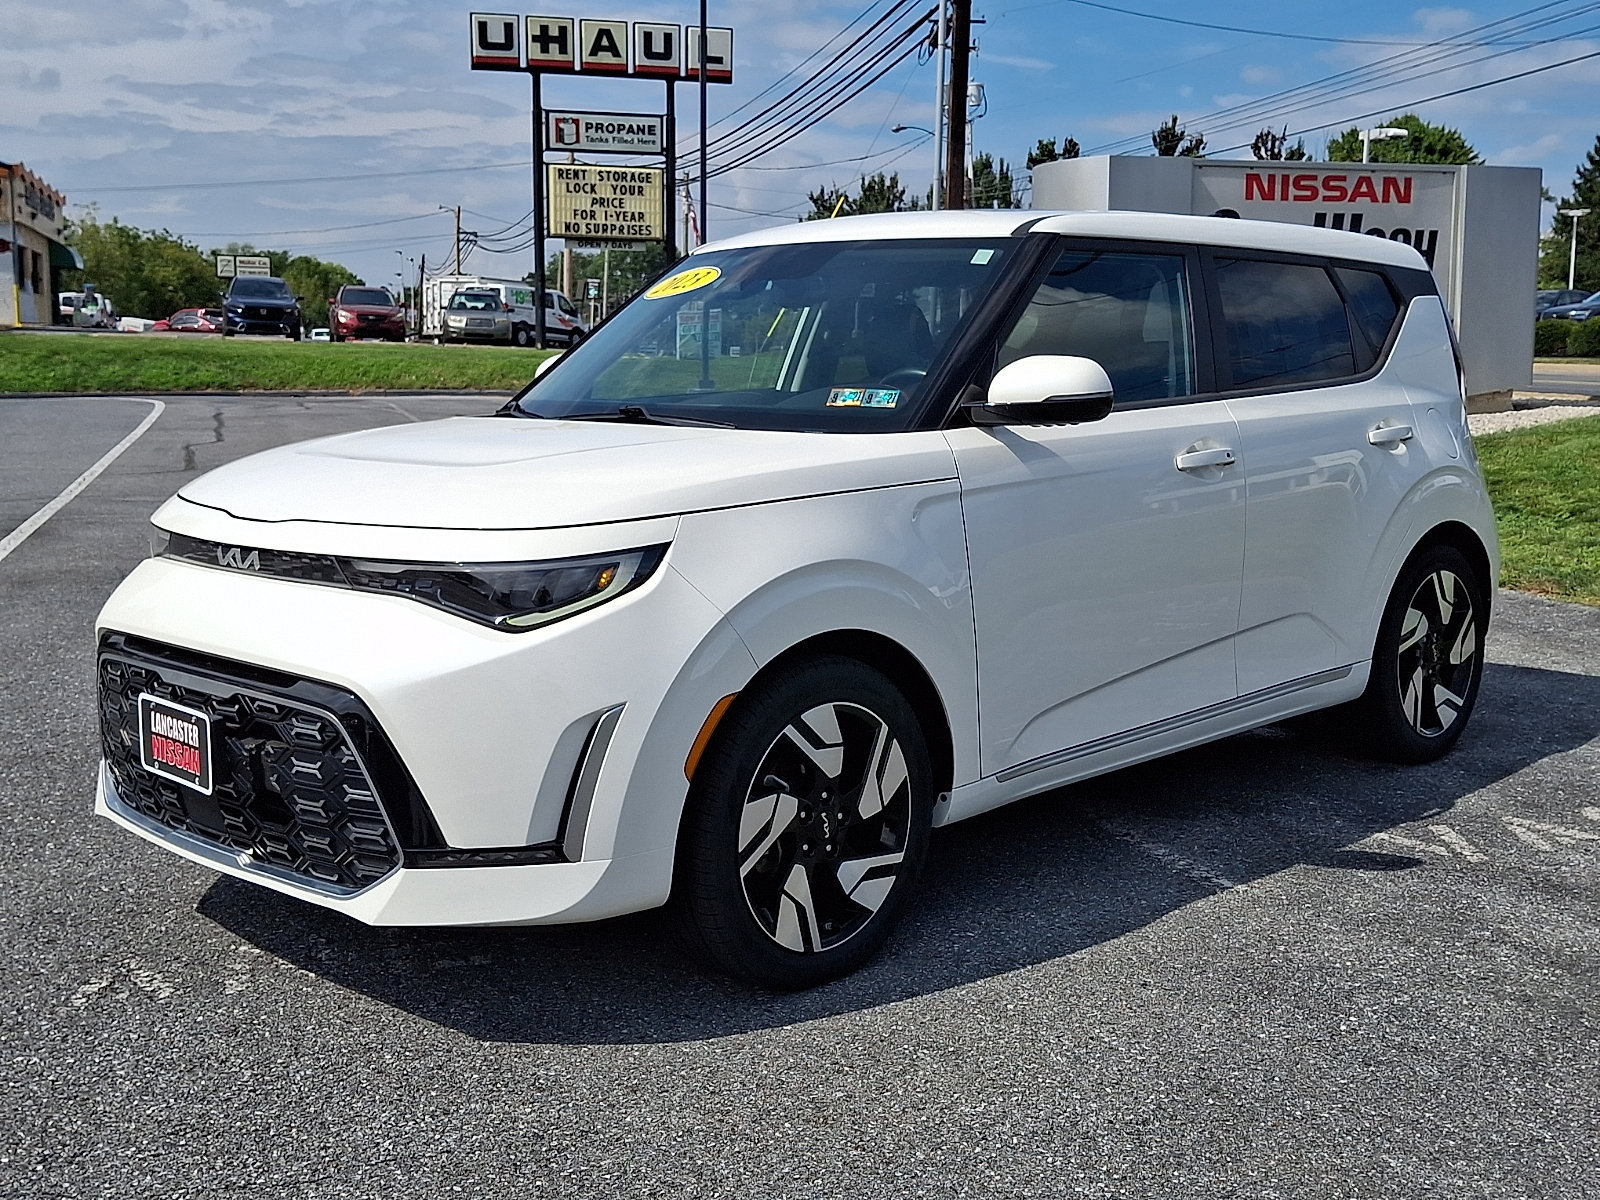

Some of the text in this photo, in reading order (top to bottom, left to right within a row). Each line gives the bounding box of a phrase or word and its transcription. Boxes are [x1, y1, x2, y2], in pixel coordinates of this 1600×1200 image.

[585, 121, 657, 136] PROPANE
[585, 135, 656, 146] Tanks Filled Here
[557, 168, 652, 184] RENT STORAGE
[566, 182, 644, 197] LOCK YOUR
[1245, 173, 1412, 204] NISSAN
[591, 196, 625, 209] PRICE
[573, 209, 597, 221] FOR
[564, 221, 652, 236] NO SURPRISES
[577, 241, 633, 250] OPEN 7 DAYS
[151, 710, 199, 748] LANCASTER
[151, 734, 200, 776] NISSAN
